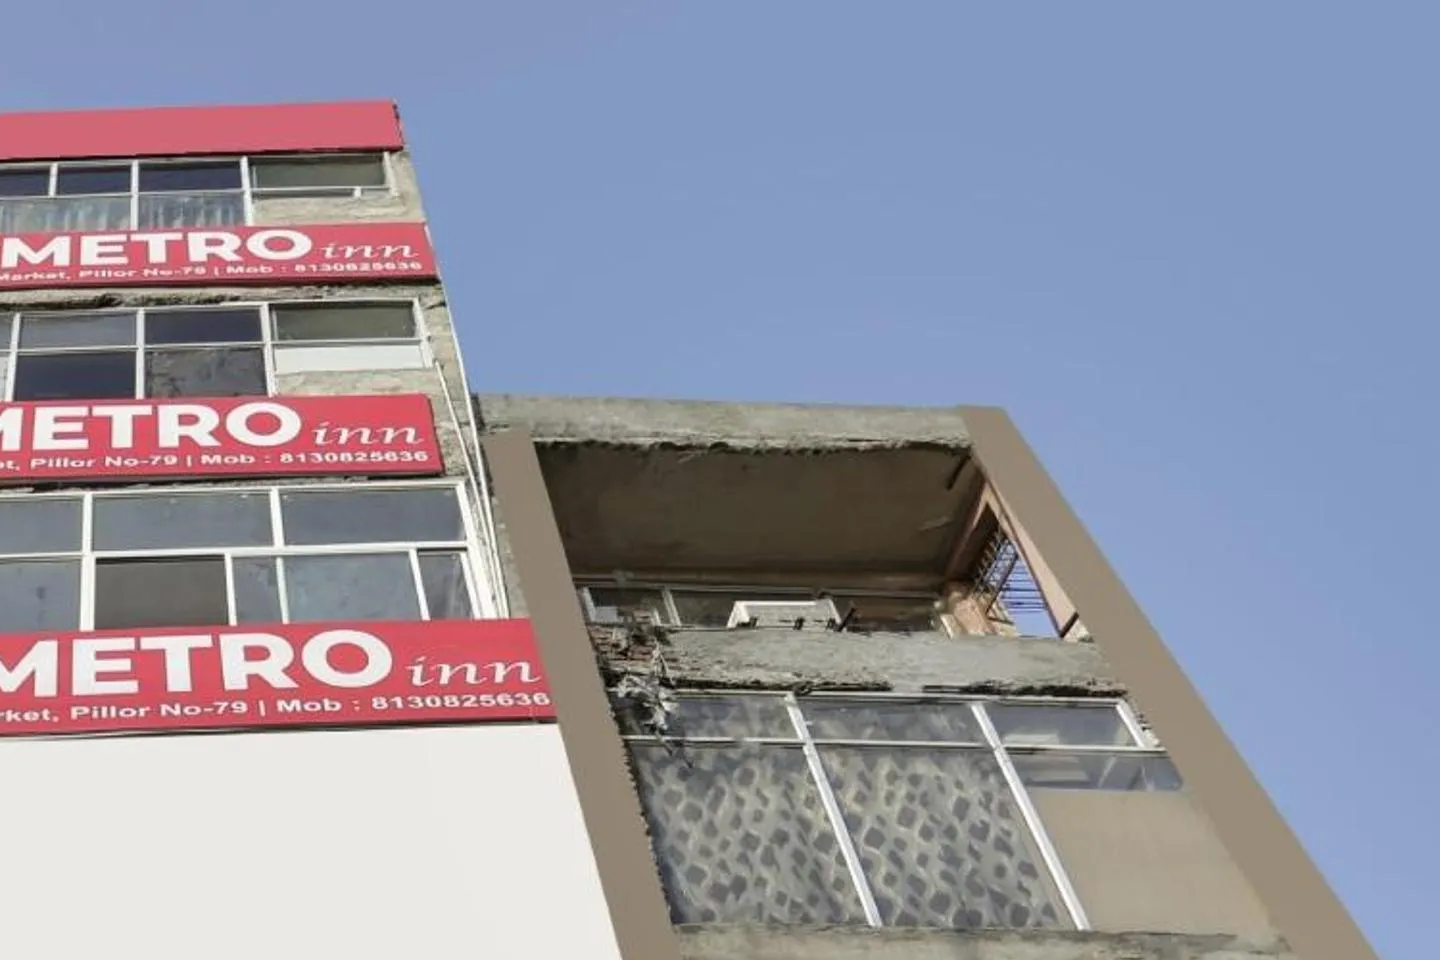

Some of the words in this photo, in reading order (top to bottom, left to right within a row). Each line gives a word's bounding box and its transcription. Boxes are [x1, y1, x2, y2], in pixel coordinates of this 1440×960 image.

[1, 229, 313, 269] METRO
[318, 240, 420, 260] inn
[312, 420, 425, 447] inn
[104, 455, 178, 468] No-79
[200, 454, 256, 465] Mob
[406, 656, 542, 687] inn
[70, 704, 151, 720] Pillor
[159, 700, 249, 718] No-79
[276, 697, 342, 714] Mob
[371, 692, 551, 711] 8130825636
